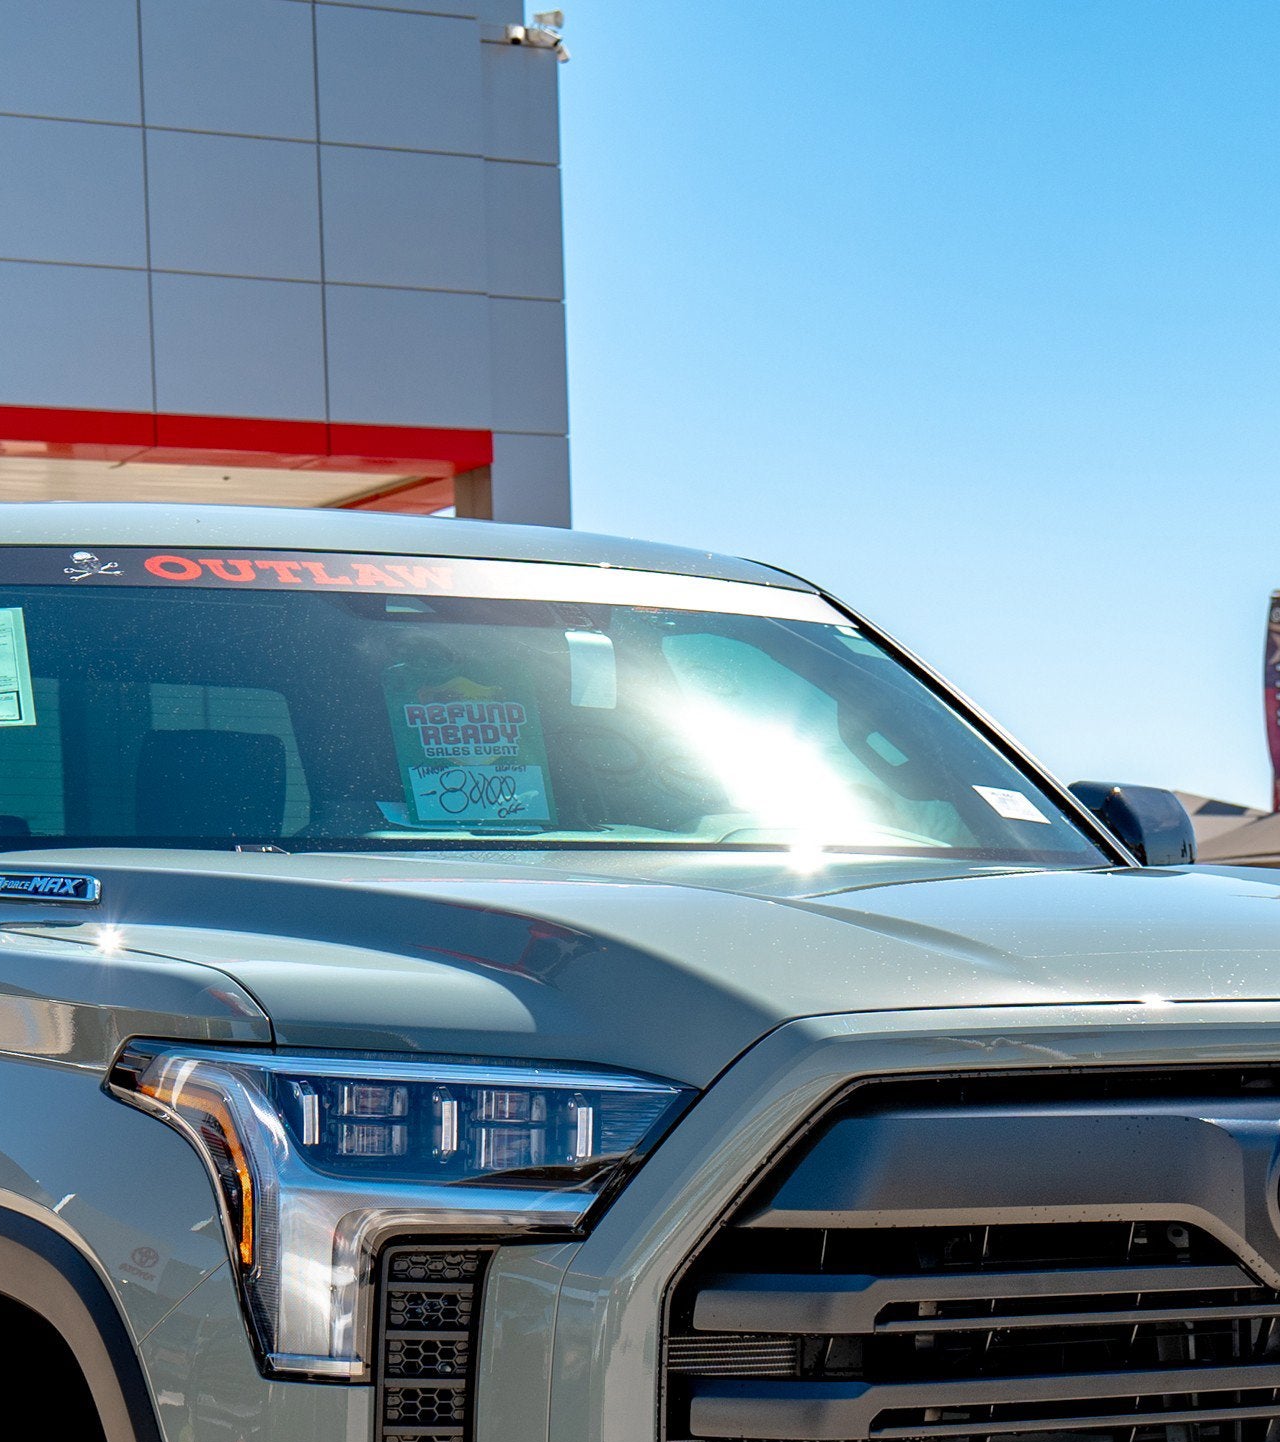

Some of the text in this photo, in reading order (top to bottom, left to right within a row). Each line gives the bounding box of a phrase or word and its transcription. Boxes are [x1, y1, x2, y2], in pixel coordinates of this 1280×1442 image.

[143, 554, 457, 591] OUTLAW
[406, 703, 526, 726] REFUND
[421, 724, 519, 746] READY
[426, 745, 519, 757] SALES EVENT
